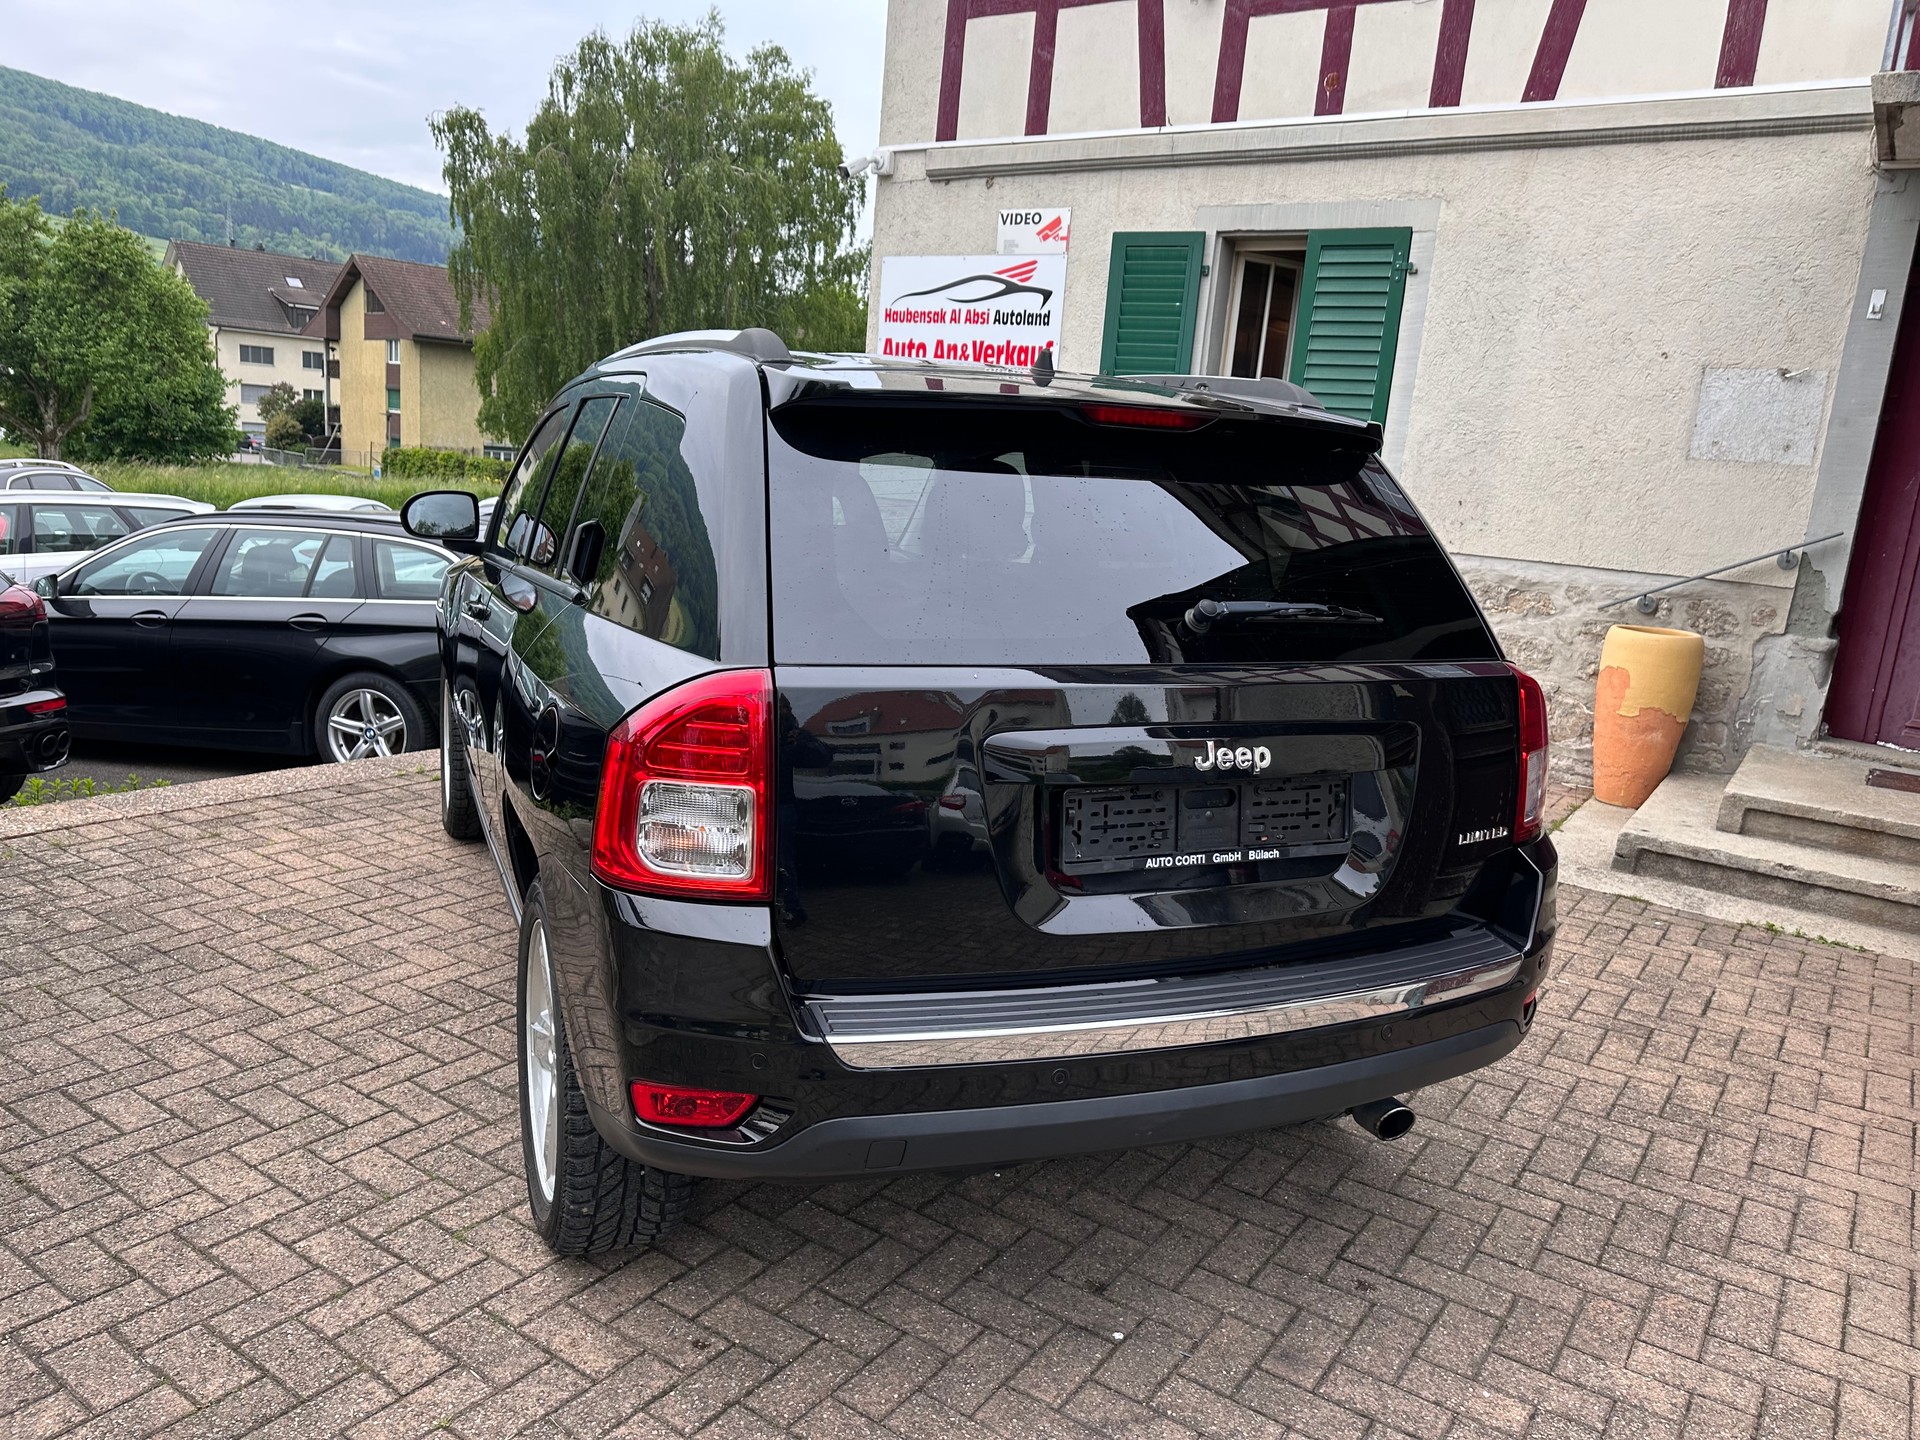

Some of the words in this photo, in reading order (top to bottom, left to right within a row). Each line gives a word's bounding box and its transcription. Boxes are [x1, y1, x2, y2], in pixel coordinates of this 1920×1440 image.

[1001, 212, 1042, 226] VIDEO
[884, 307, 946, 325] Haubensak
[949, 308, 961, 325] Al
[964, 309, 990, 326] Absi
[993, 309, 1051, 327] Autoland
[883, 337, 927, 359] Auto
[1194, 741, 1271, 775] Jeep
[1145, 857, 1173, 869] AUTO
[1175, 854, 1206, 866] CORTI
[1212, 851, 1242, 863] GmbH
[1248, 848, 1280, 860] Bülach
